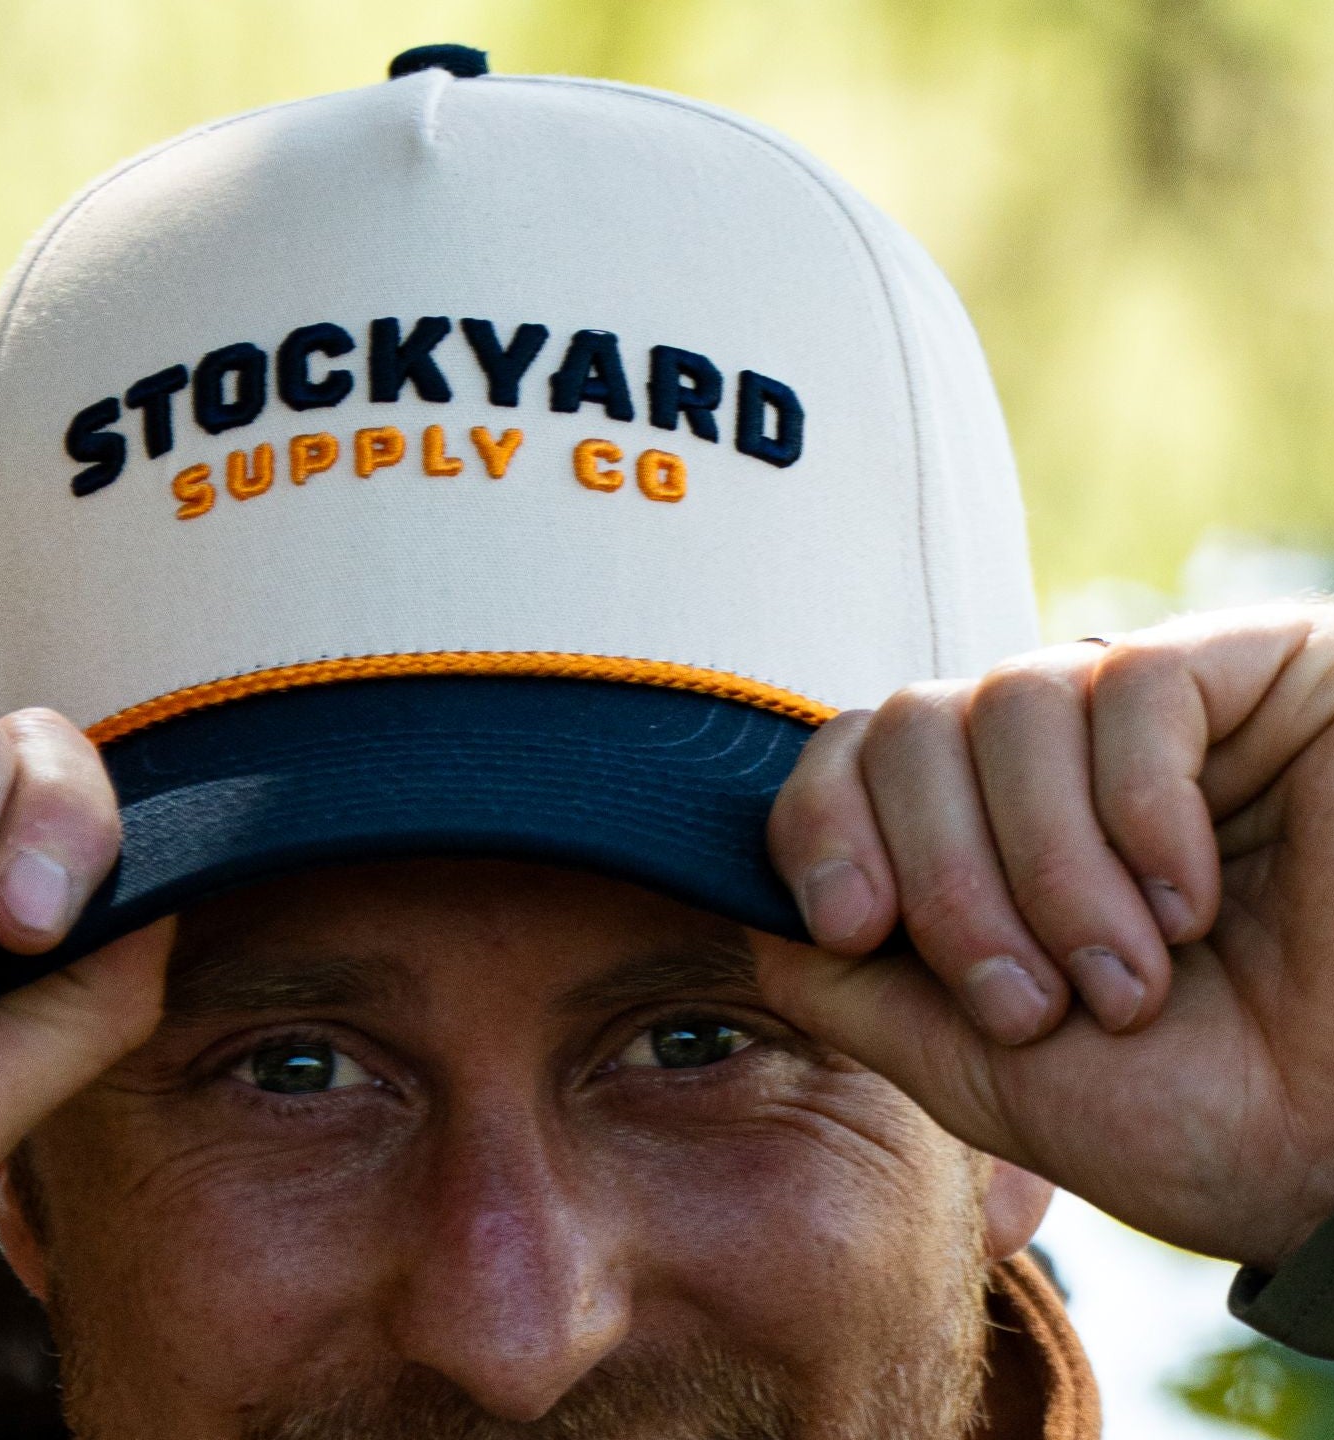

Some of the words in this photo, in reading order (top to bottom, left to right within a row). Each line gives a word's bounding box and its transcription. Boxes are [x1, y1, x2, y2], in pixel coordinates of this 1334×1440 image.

[66, 316, 805, 498] STOCKYARD
[171, 424, 524, 521] SUPPLY
[571, 437, 688, 503] CO
